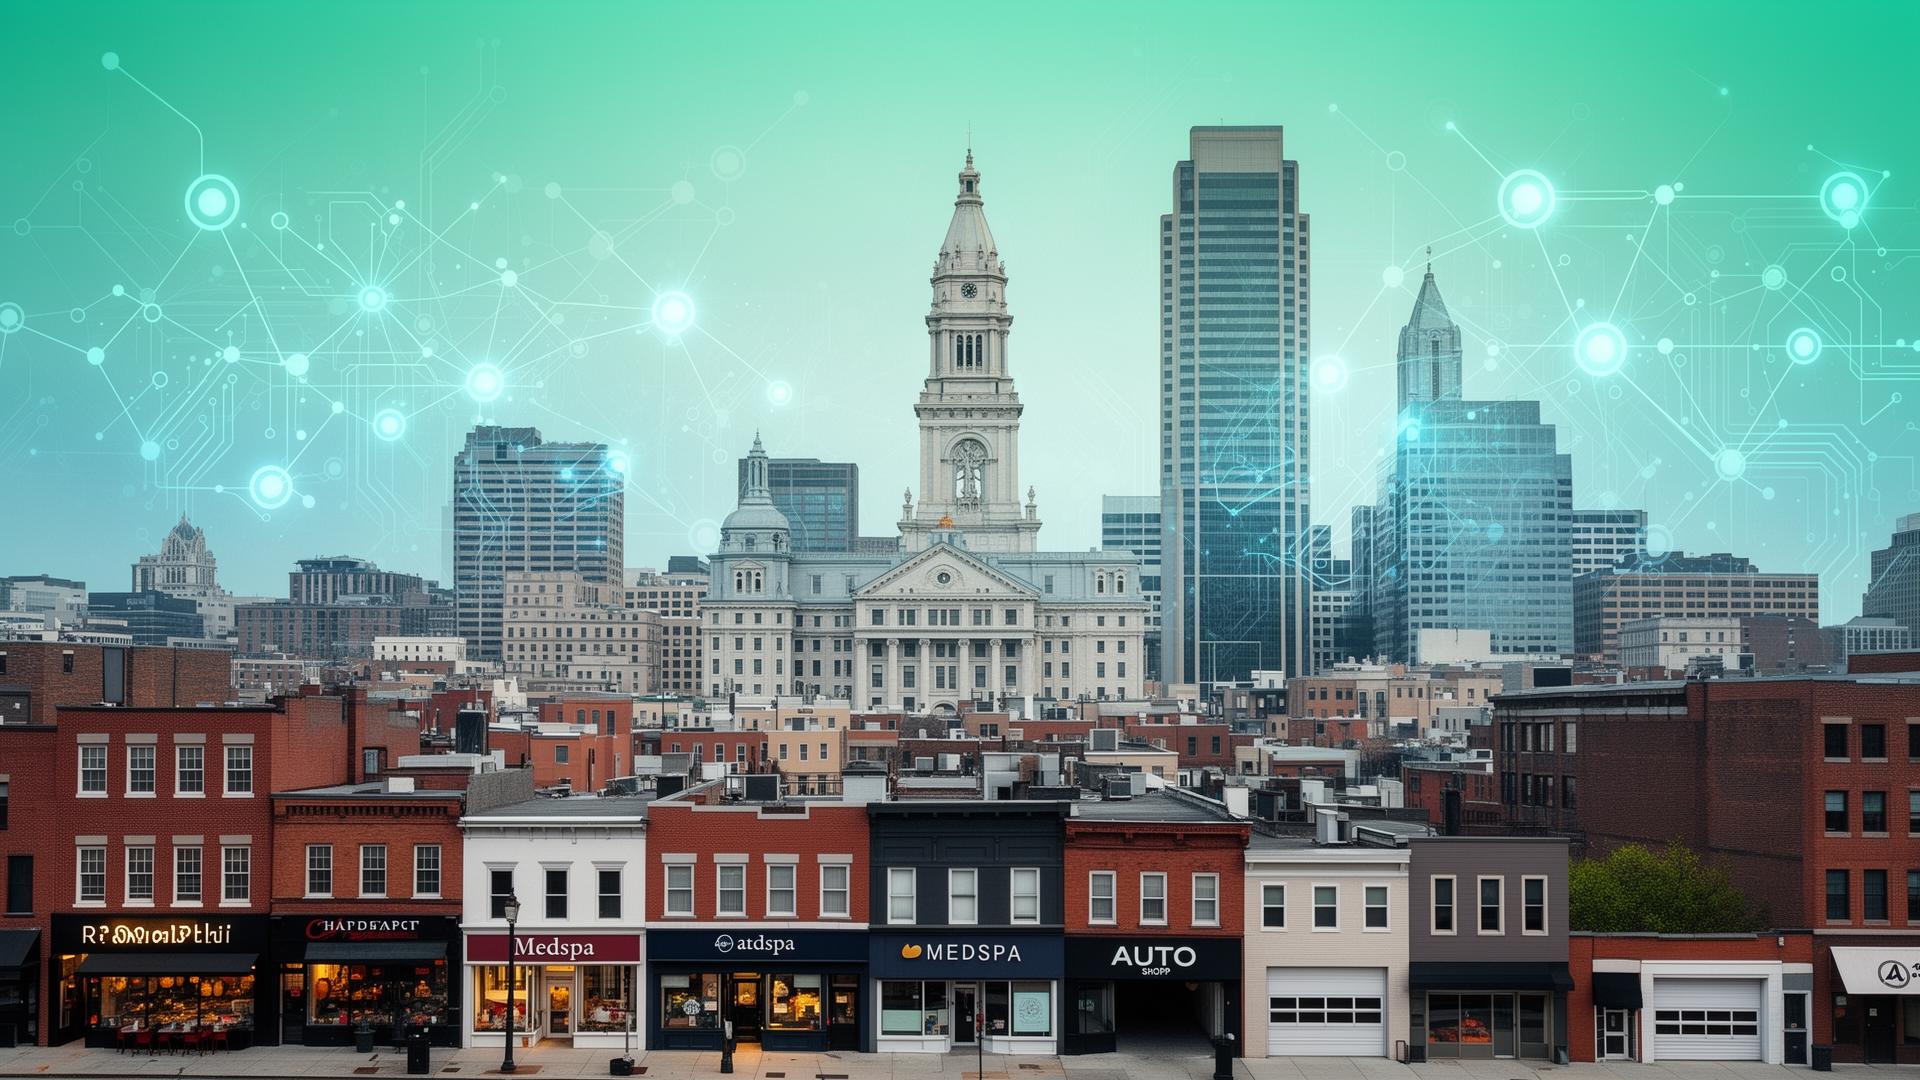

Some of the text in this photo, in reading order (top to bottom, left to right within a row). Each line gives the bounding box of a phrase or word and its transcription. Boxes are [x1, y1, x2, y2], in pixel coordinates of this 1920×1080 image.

[514, 937, 595, 961] Medspa
[736, 934, 796, 956] atdspa
[927, 943, 1022, 962] MEDSPA
[1111, 945, 1197, 967] AUTO
[1141, 967, 1171, 976] SHOPP
